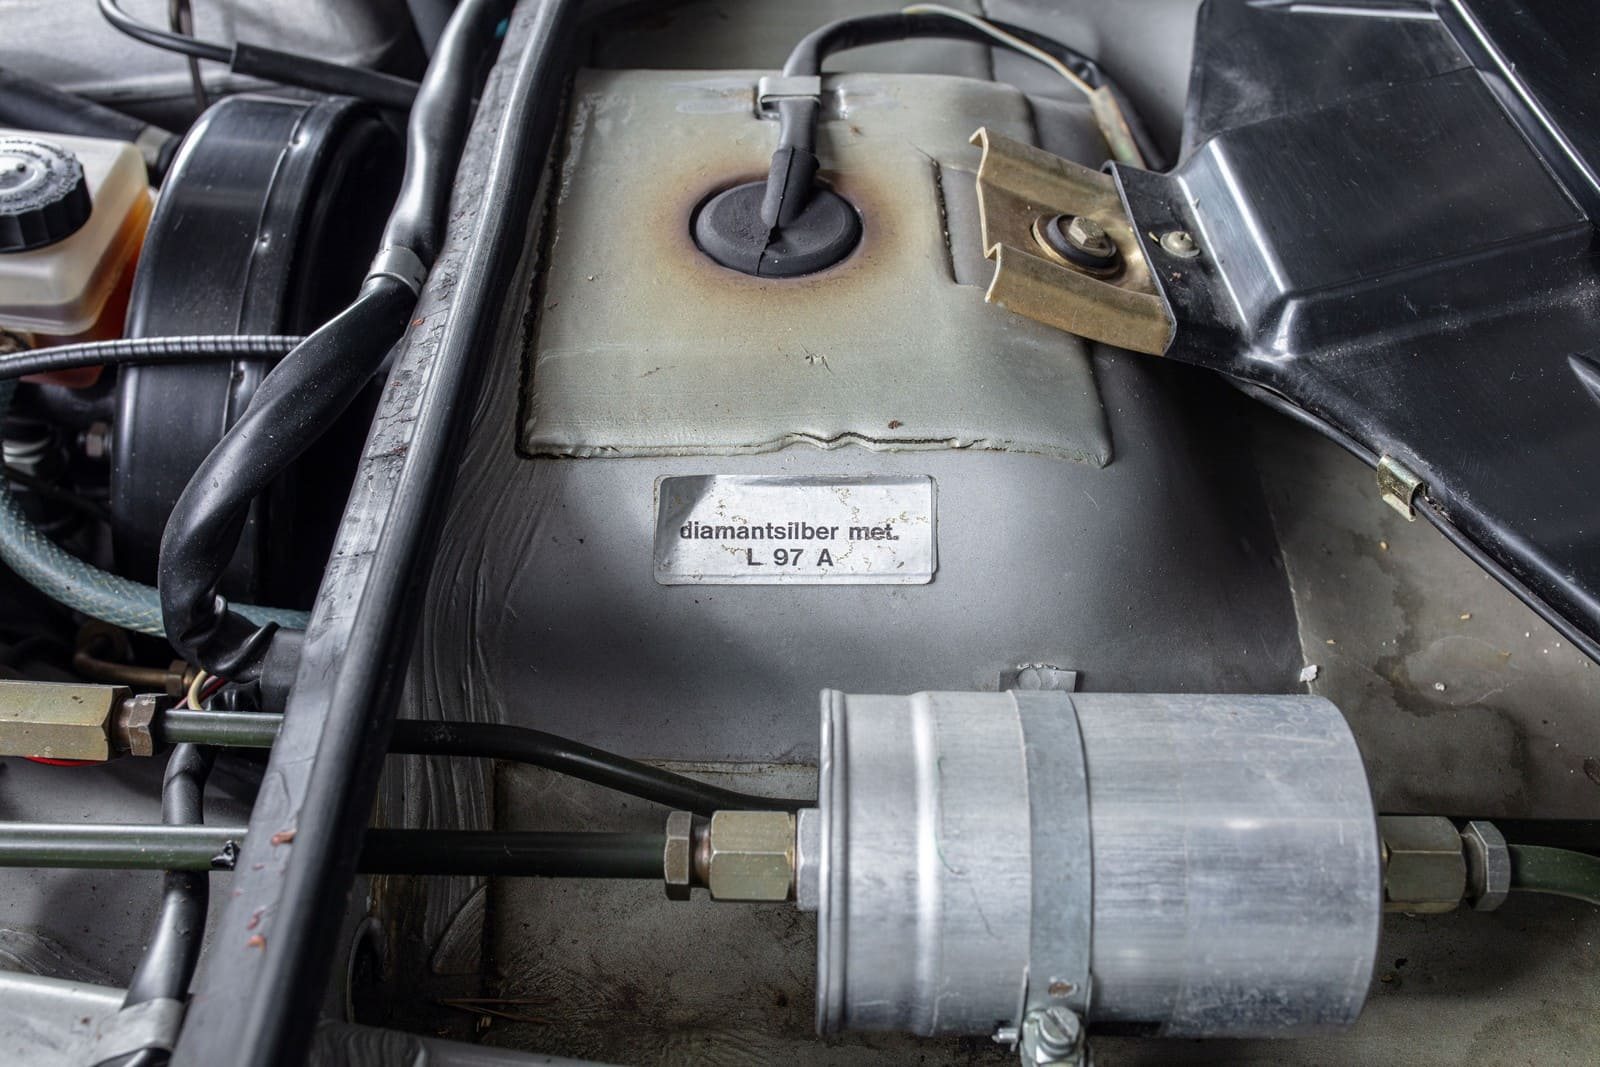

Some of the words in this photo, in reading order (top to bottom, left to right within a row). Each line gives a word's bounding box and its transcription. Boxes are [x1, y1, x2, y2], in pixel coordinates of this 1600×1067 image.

[680, 521, 839, 540] diamantsilber
[849, 523, 899, 540] met.
[747, 549, 764, 566] L
[773, 549, 803, 566] 97
[816, 549, 834, 566] A
